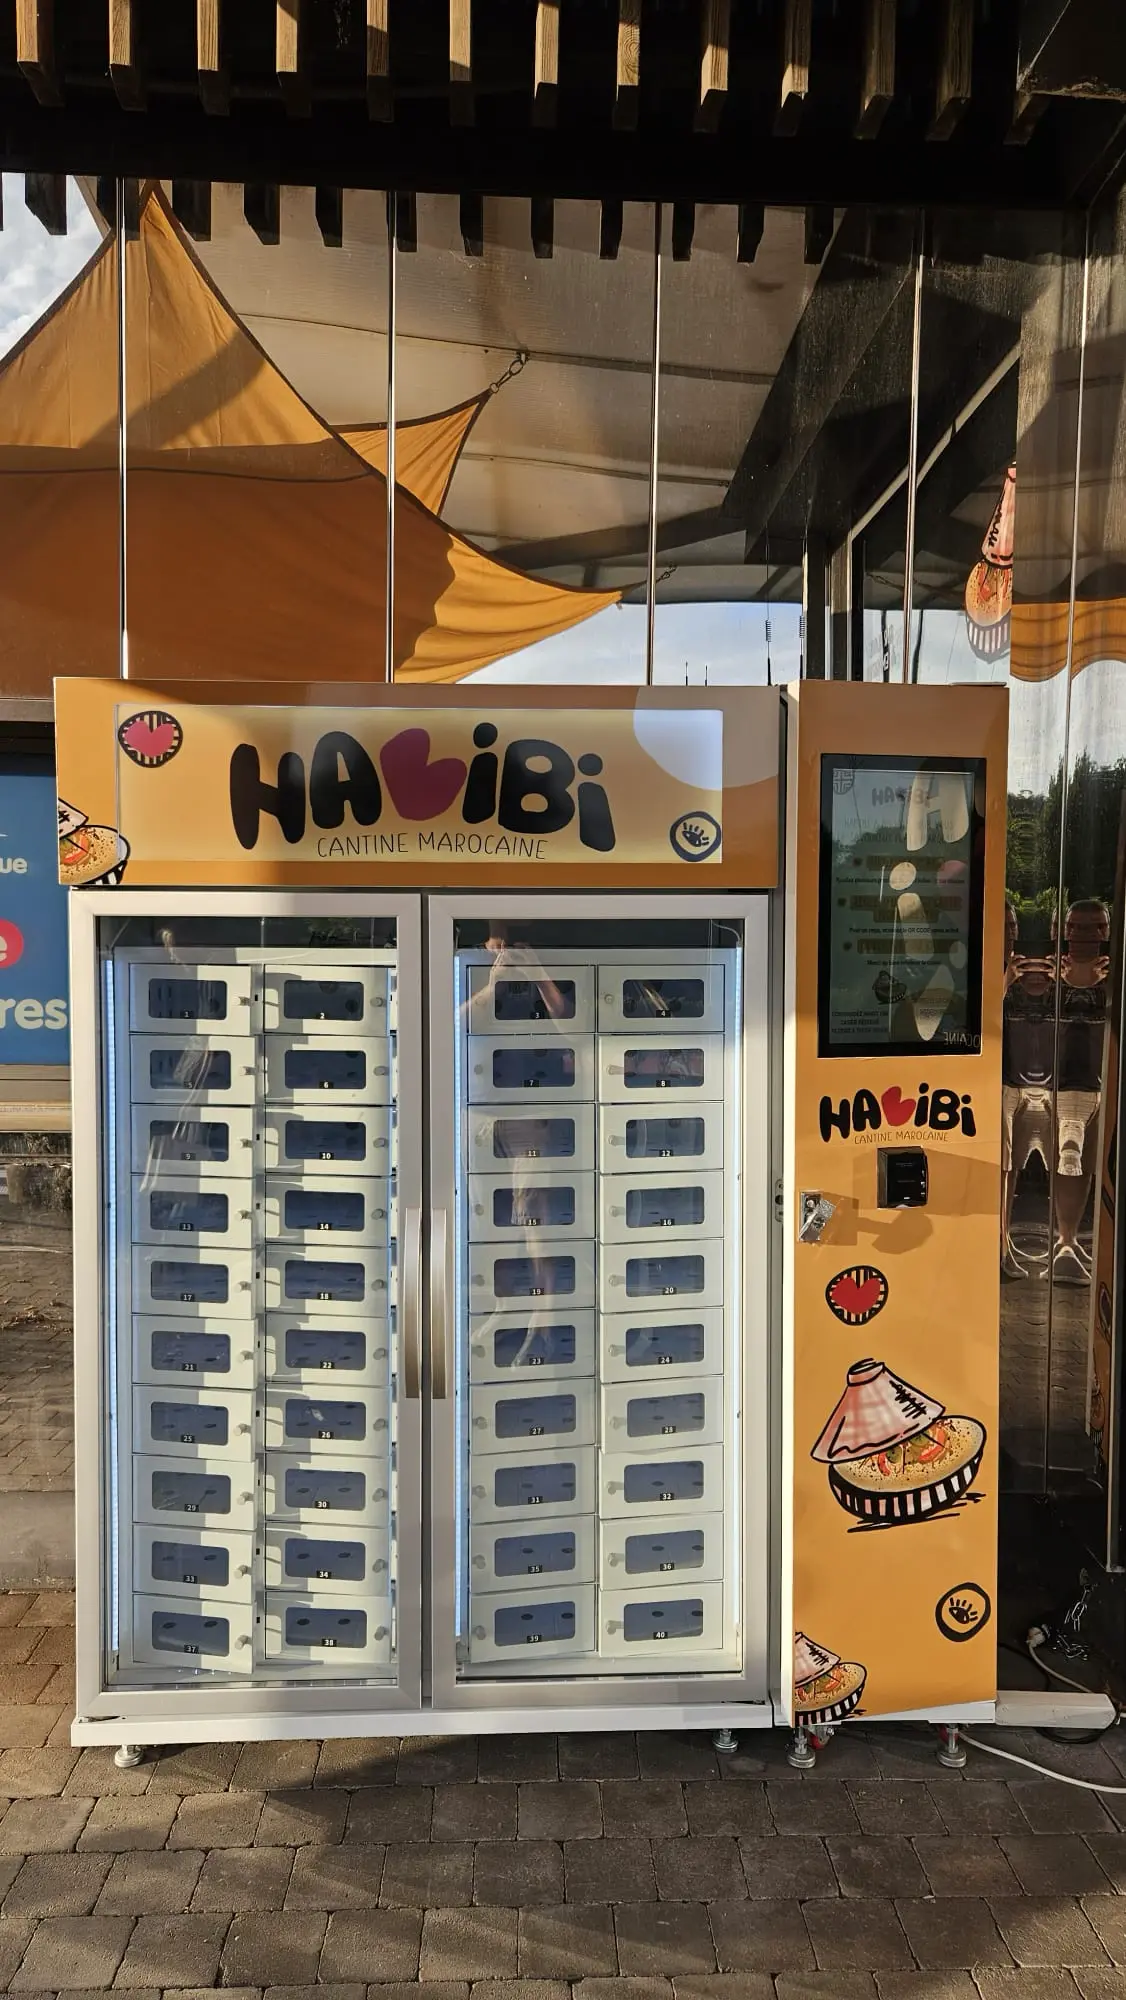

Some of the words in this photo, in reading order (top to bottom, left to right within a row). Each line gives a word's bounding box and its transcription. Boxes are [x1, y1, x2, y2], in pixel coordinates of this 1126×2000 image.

[317, 833, 409, 858] CANTINE
[418, 832, 550, 860] MAROCAINE
[854, 1131, 893, 1145] CANTINE
[895, 1130, 949, 1142] MAROCAINE
